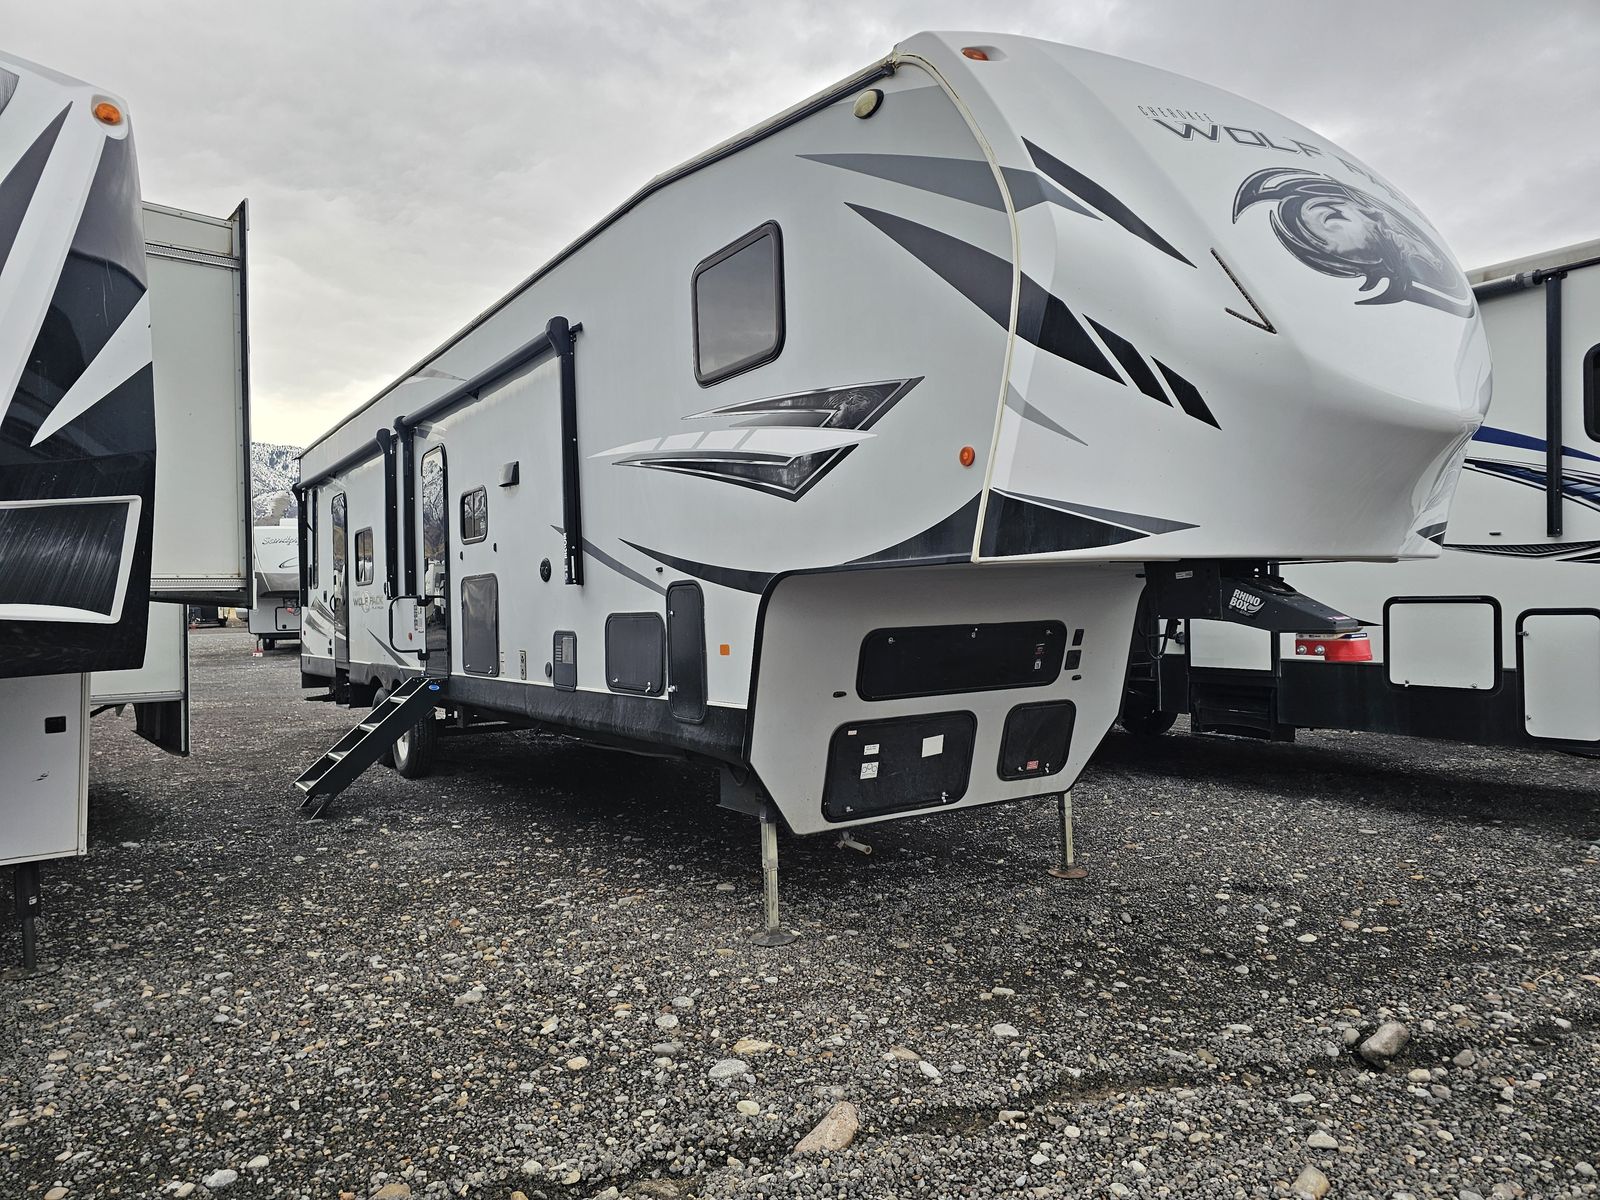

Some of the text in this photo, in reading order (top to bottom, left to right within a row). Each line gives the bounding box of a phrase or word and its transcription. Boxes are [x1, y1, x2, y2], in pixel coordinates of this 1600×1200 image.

[1136, 105, 1214, 122] CHEROKEE
[1150, 118, 1323, 157] WOLF
[352, 597, 369, 606] WOLF
[1230, 597, 1249, 611] BOX
[1233, 589, 1260, 605] RHINO
